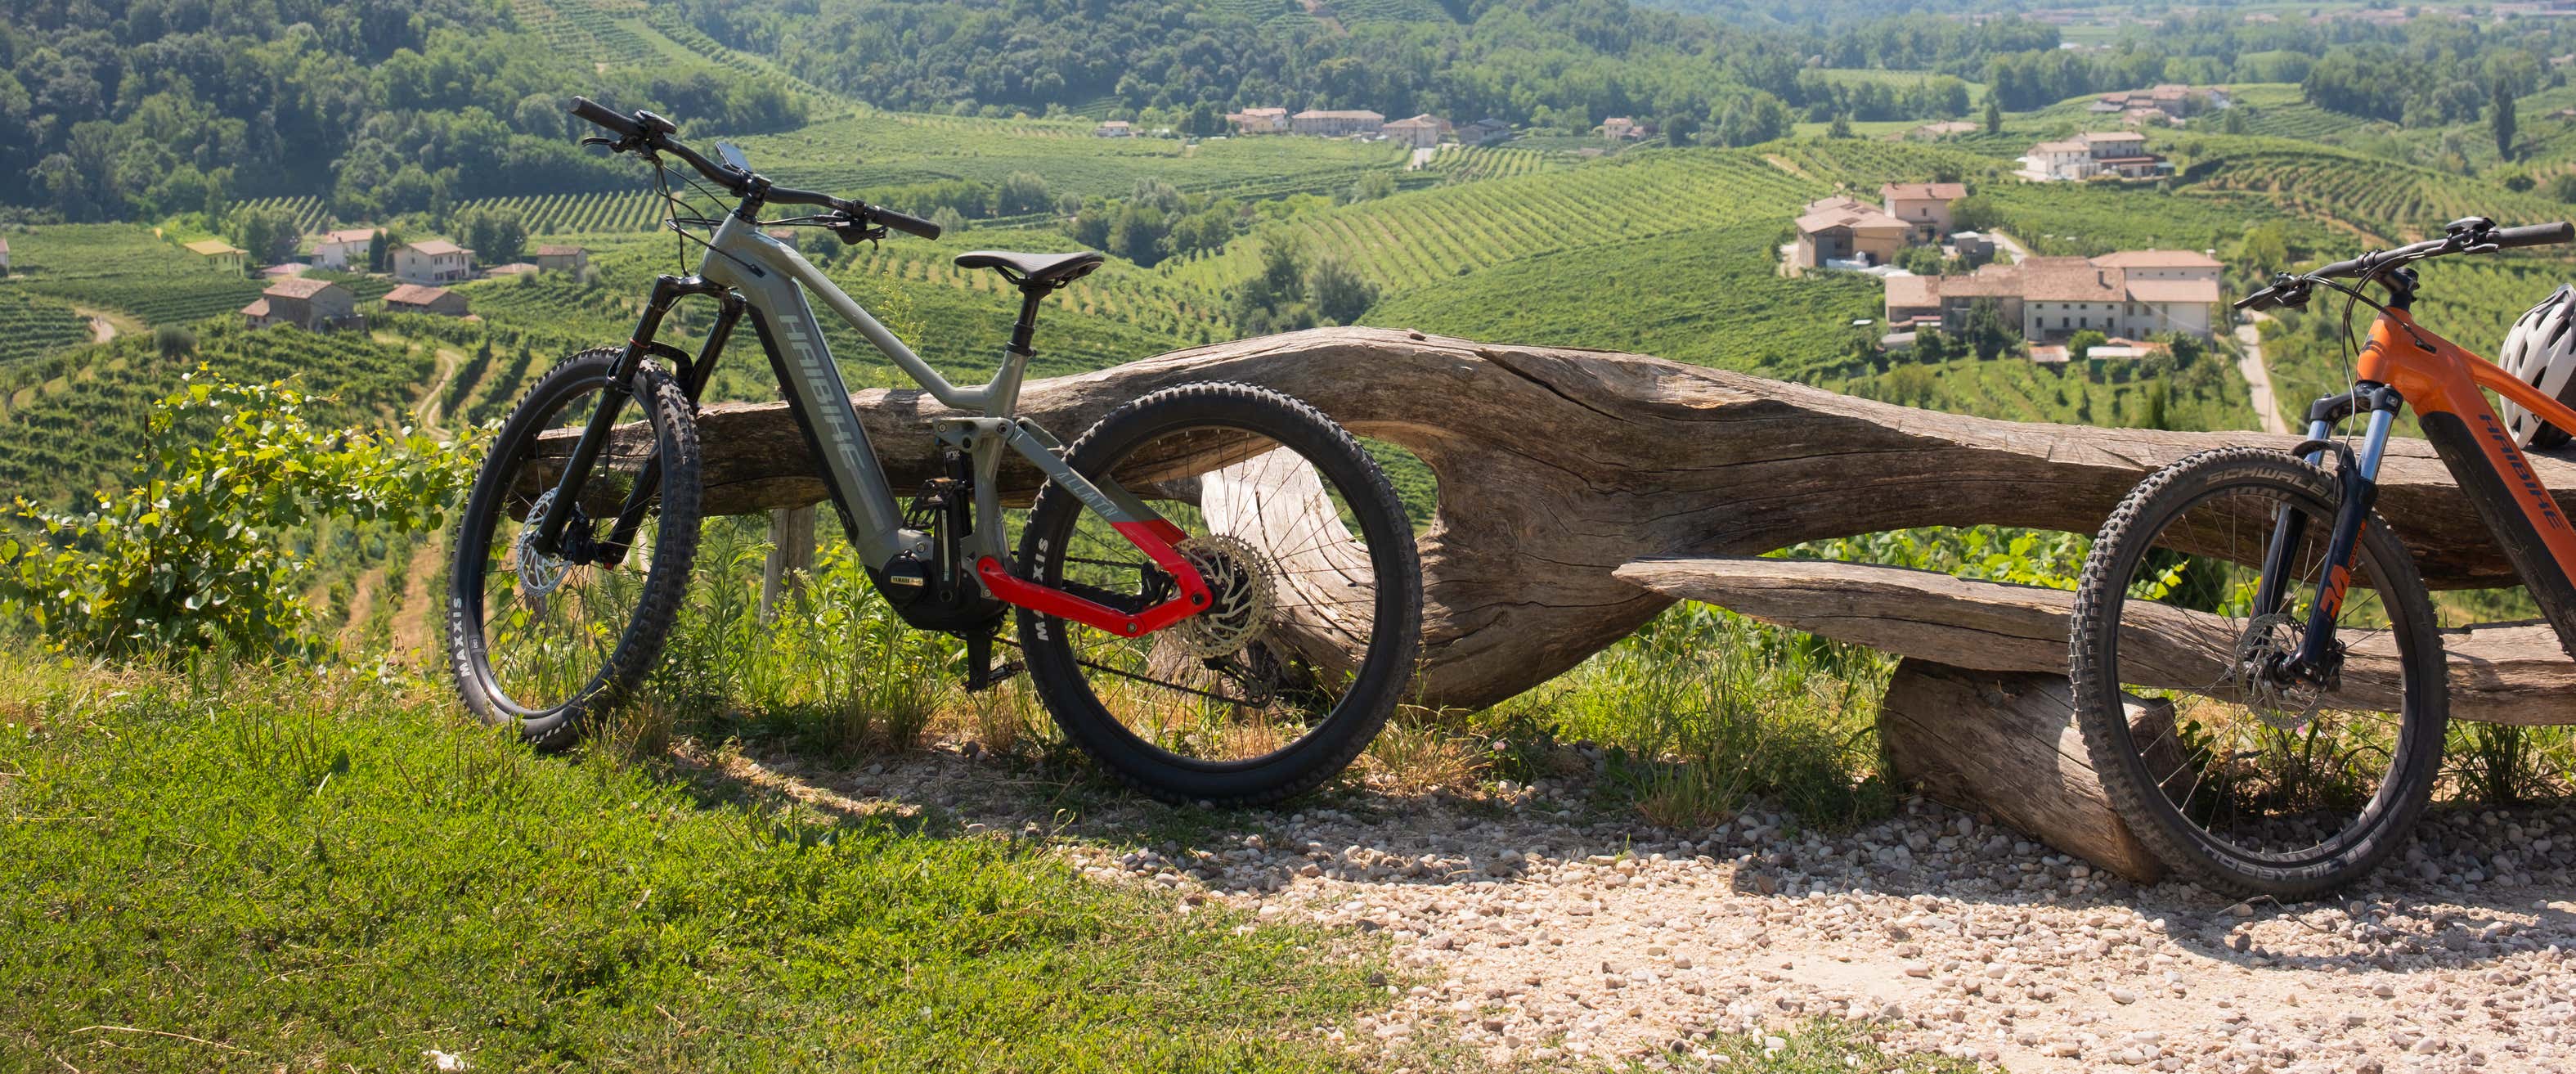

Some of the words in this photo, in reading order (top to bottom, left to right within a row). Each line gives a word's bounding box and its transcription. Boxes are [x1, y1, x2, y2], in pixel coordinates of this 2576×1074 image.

[779, 315, 865, 470] HAIBIKE
[2480, 415, 2566, 530] HAIBIKE
[453, 597, 471, 677] MAXXIS
[1032, 537, 1049, 641] MXIS
